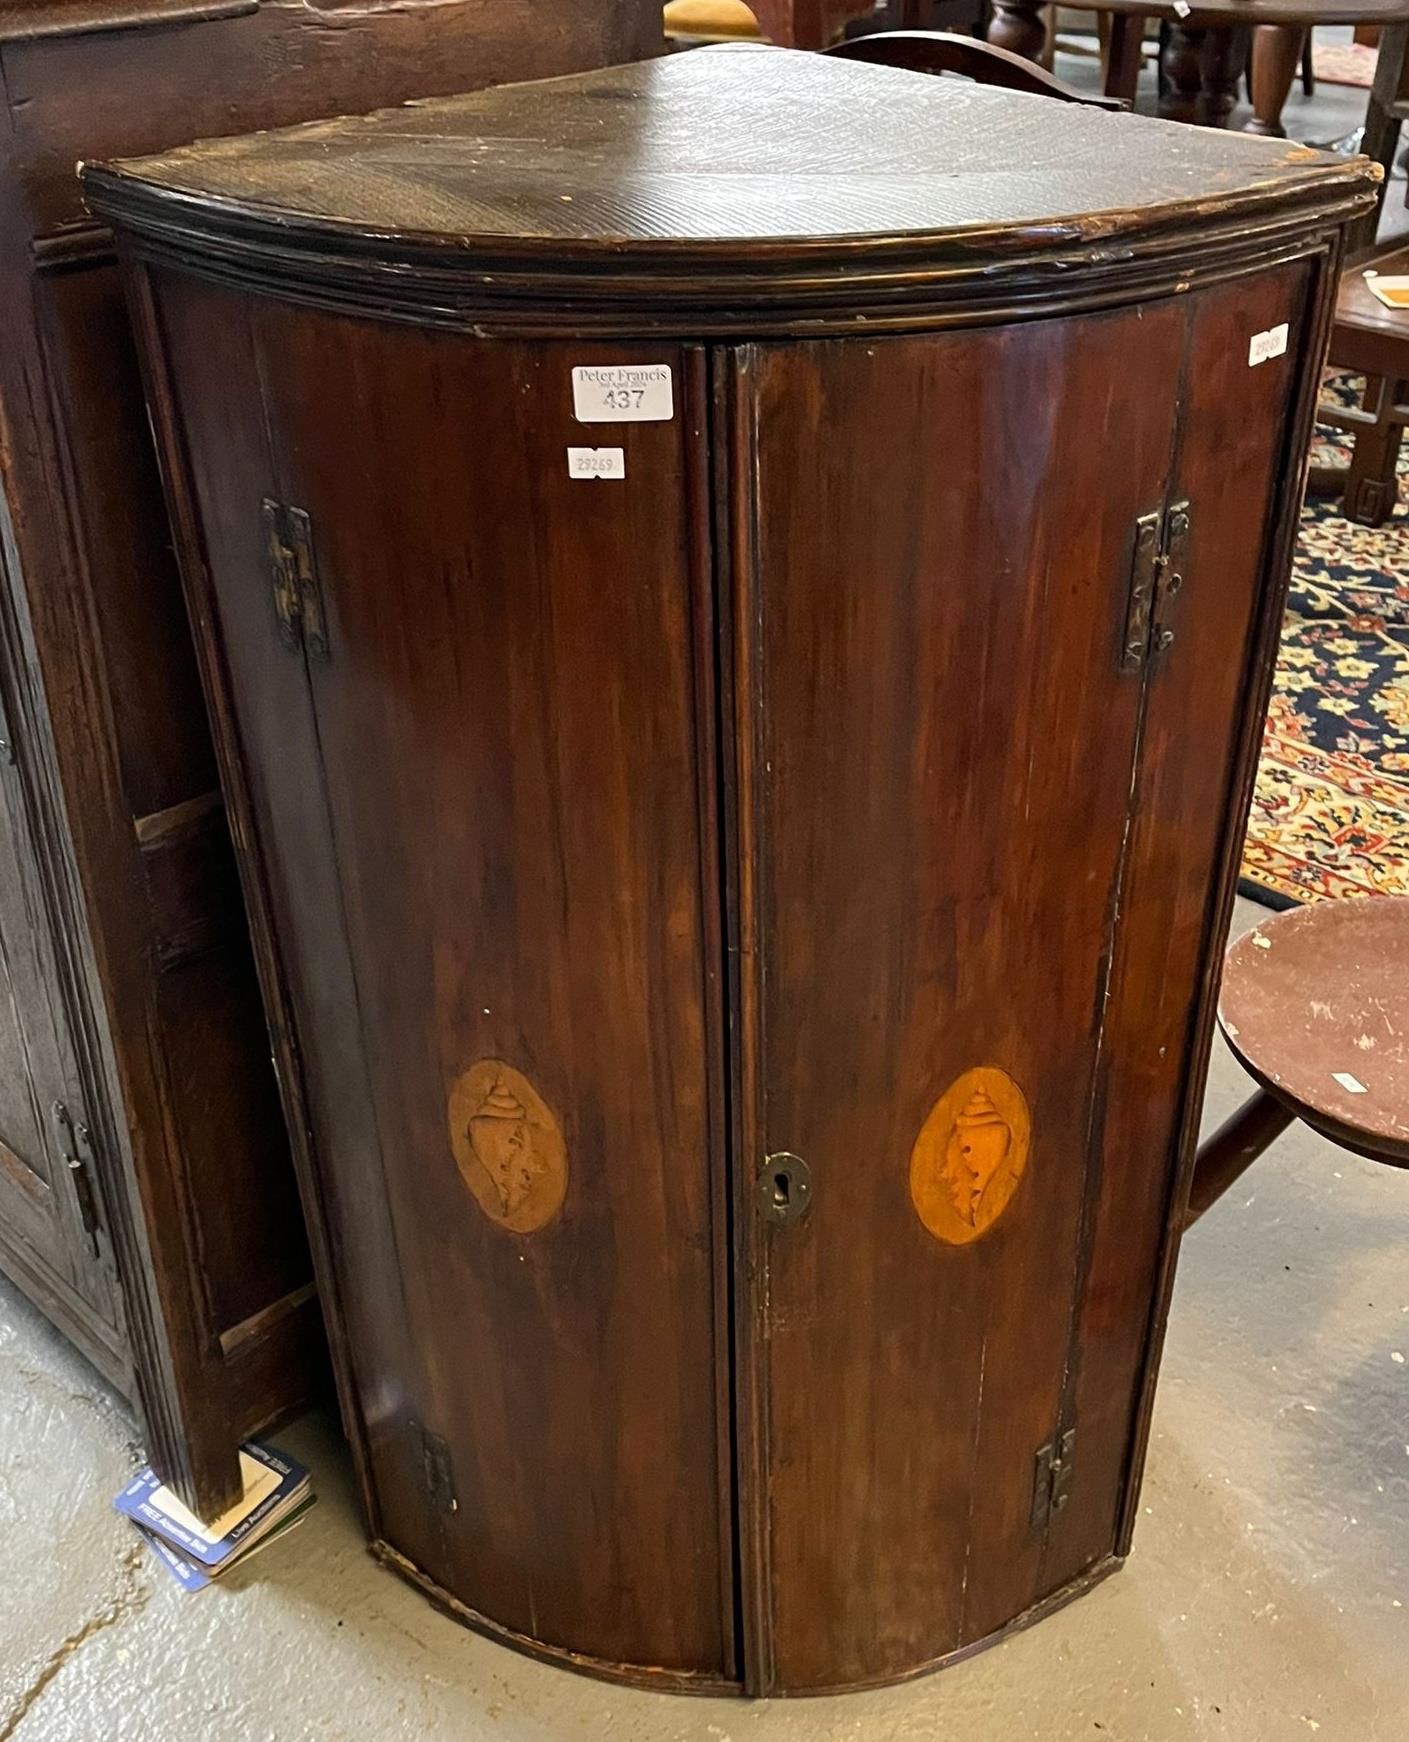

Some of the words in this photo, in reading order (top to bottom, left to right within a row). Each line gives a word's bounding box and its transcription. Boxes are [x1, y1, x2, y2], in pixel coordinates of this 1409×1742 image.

[580, 369, 614, 381] Peter
[618, 368, 667, 380] Francis
[603, 390, 645, 408] 437
[577, 458, 613, 471] 29269
[137, 1503, 161, 1521] FREE
